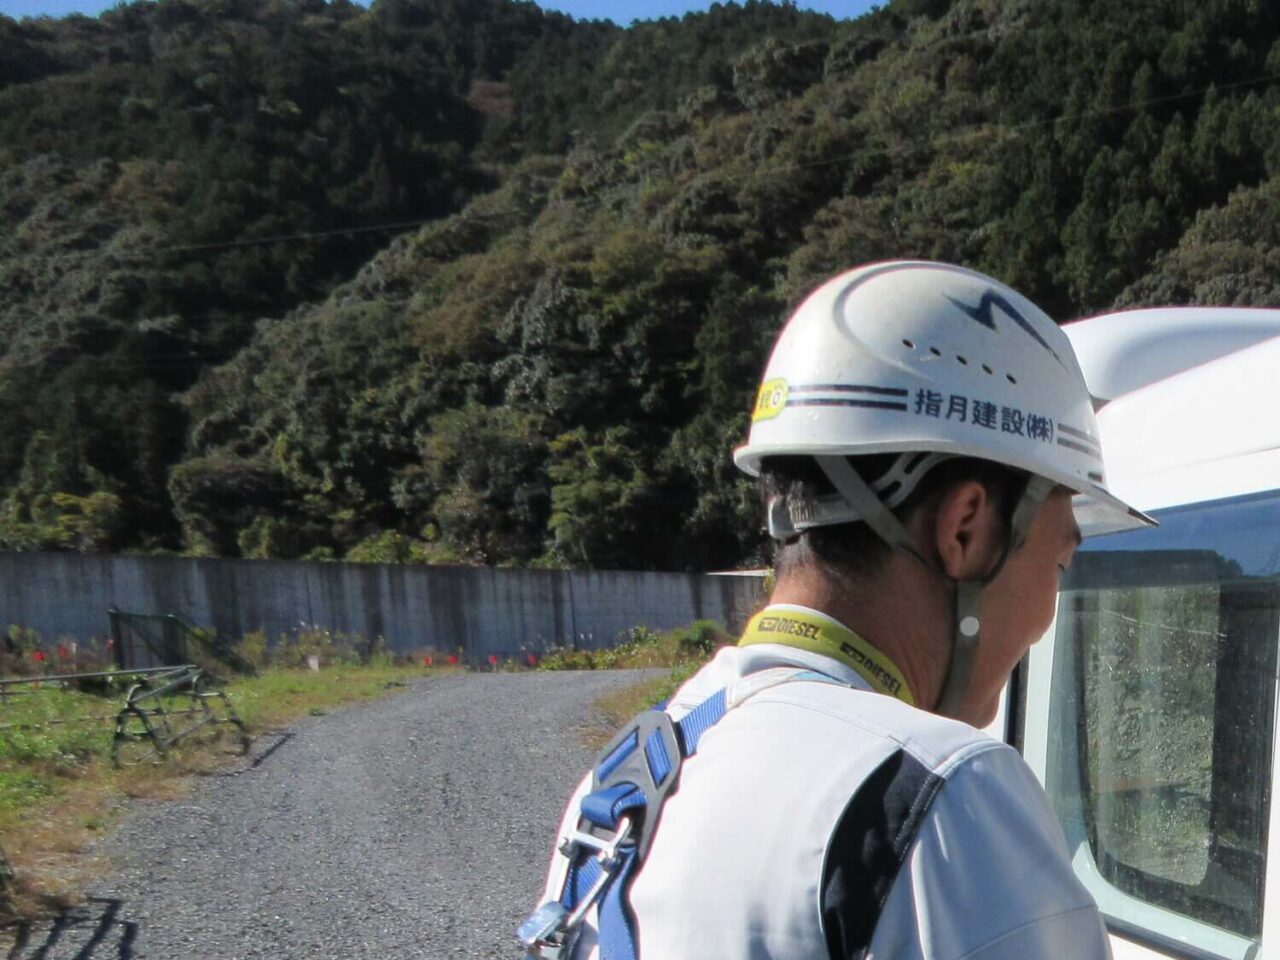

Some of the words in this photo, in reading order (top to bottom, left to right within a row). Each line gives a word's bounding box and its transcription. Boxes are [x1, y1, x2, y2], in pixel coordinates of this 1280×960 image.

[915, 389, 1054, 444] 指月建設(株)
[778, 617, 821, 641] DIESEL
[864, 655, 902, 697] DIESEL
